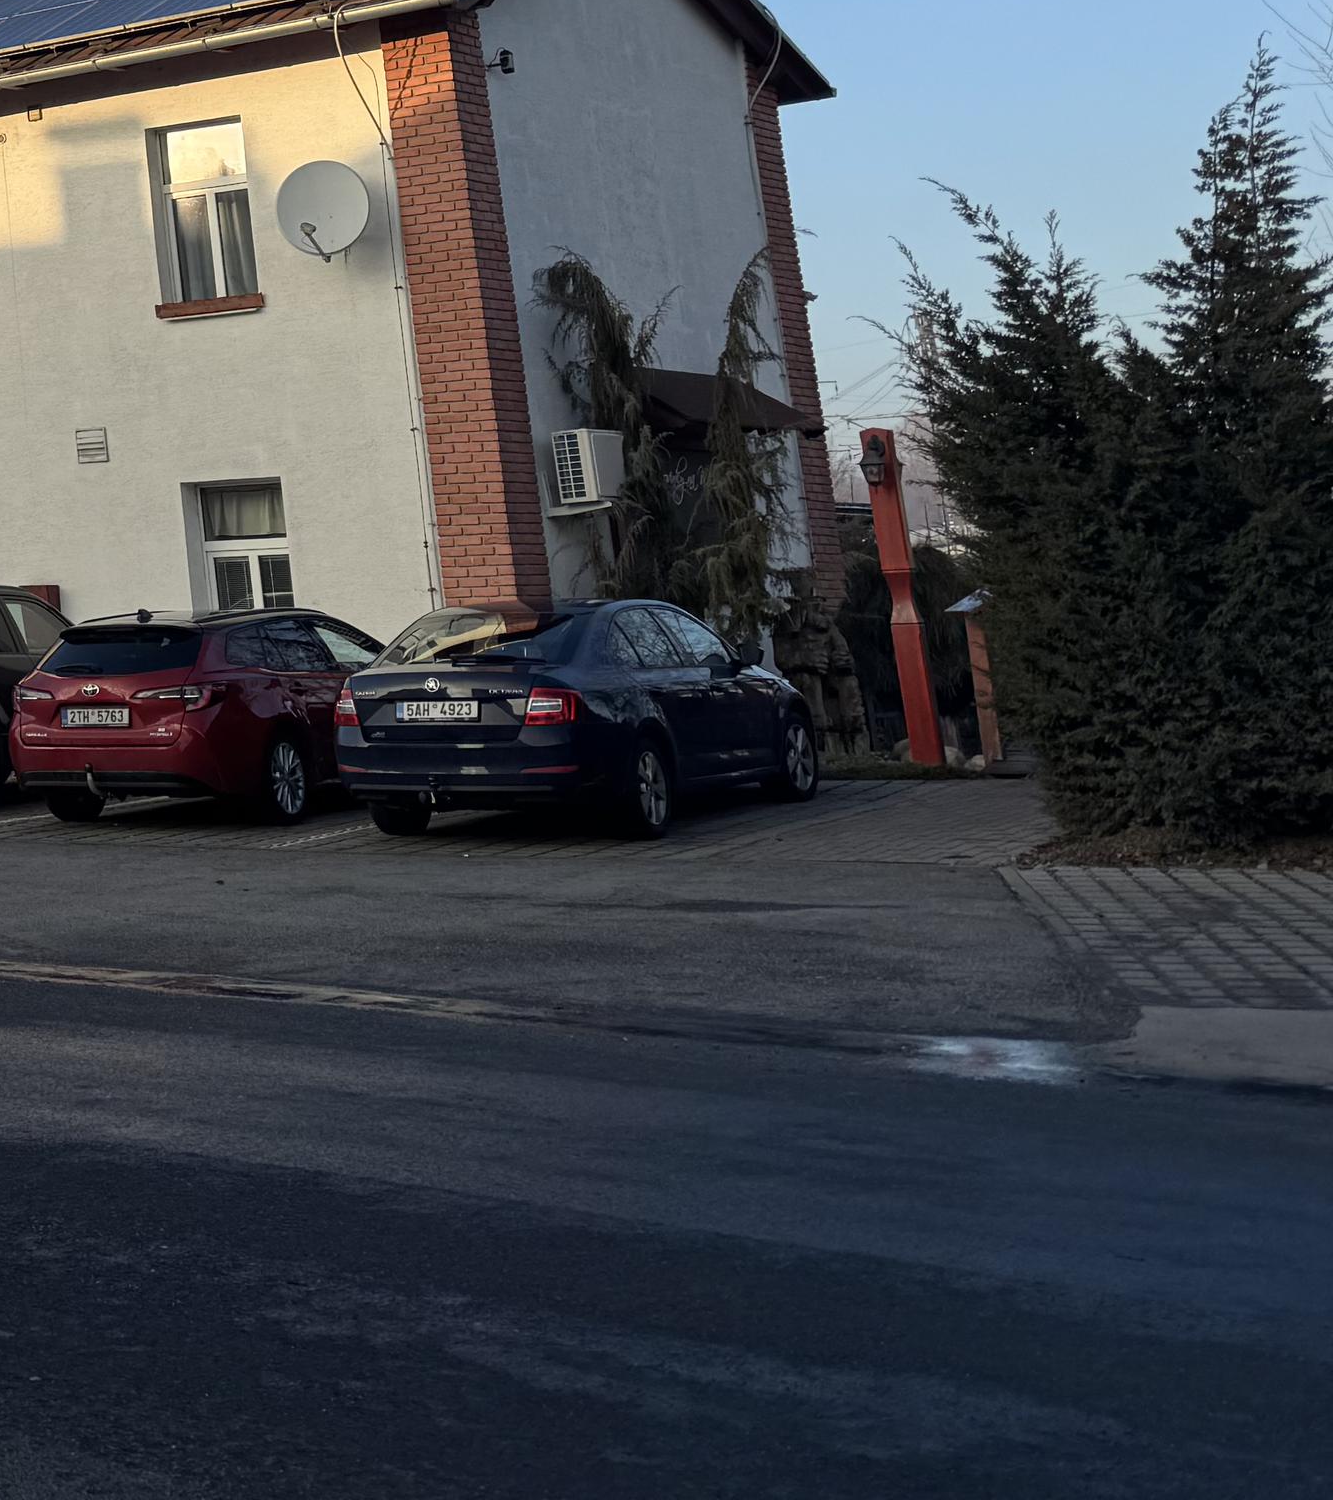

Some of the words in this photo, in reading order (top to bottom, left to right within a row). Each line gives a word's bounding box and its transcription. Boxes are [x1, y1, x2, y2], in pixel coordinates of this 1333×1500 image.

[69, 710, 90, 724] 2TH
[97, 709, 124, 723] 5763
[406, 703, 431, 717] 5AH
[439, 702, 473, 716] 4923
